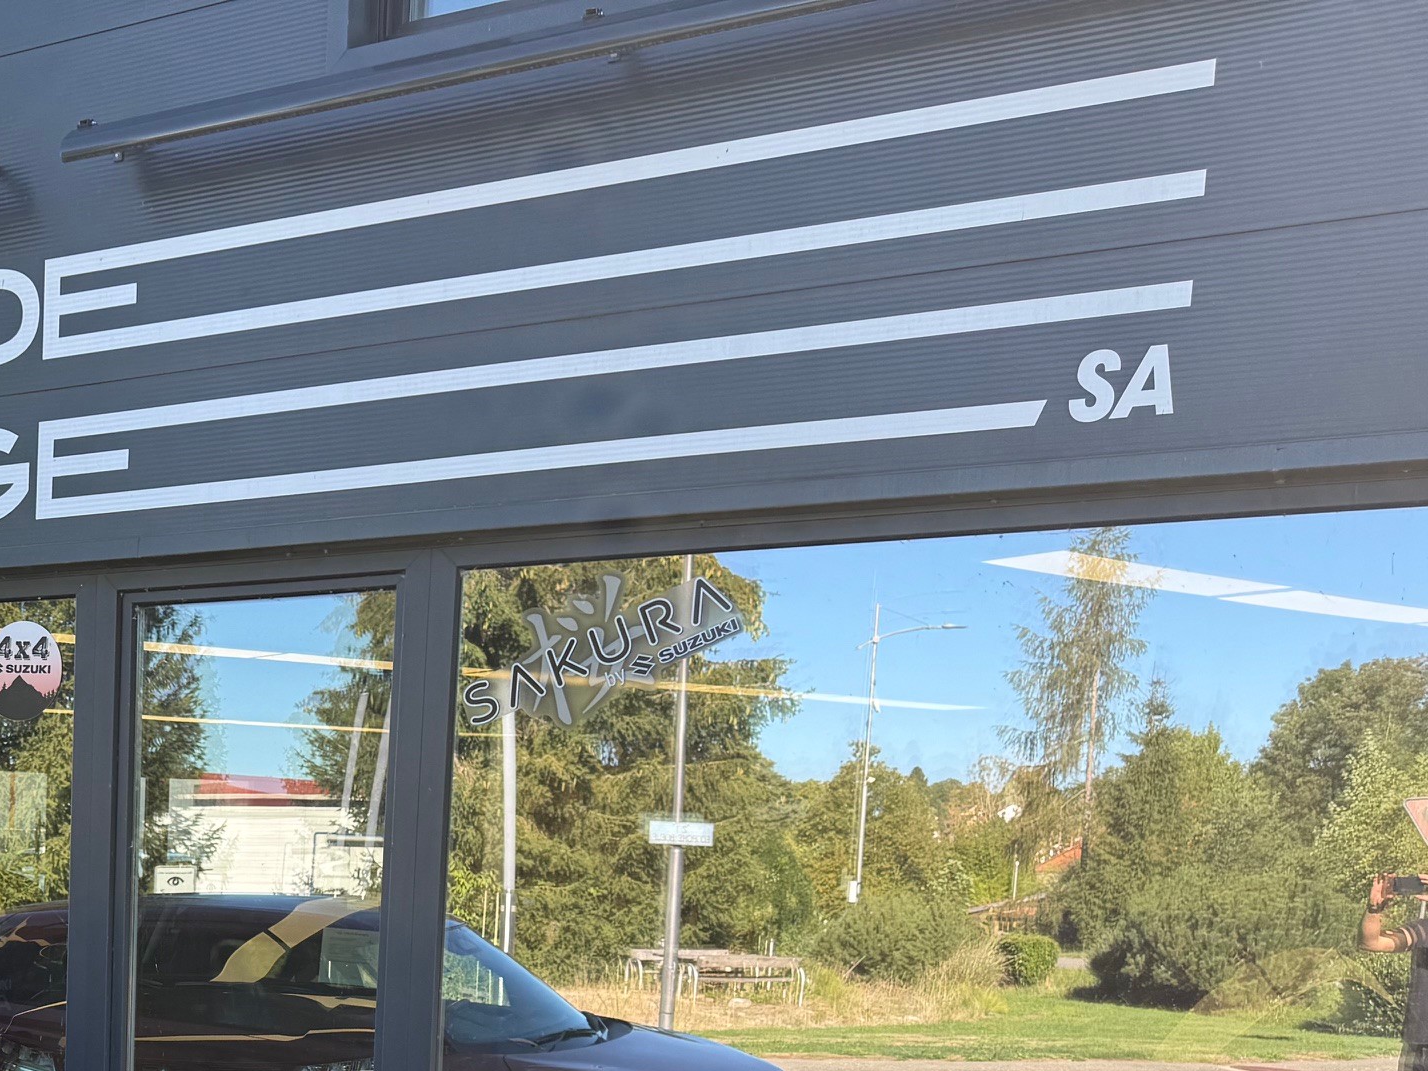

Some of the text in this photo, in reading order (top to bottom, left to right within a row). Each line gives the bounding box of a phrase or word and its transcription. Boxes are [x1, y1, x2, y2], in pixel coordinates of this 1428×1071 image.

[1068, 343, 1174, 423] SA
[5, 663, 51, 674] SUZUKI
[463, 575, 733, 726] SAKURA
[604, 616, 741, 687] by SUZUKI
